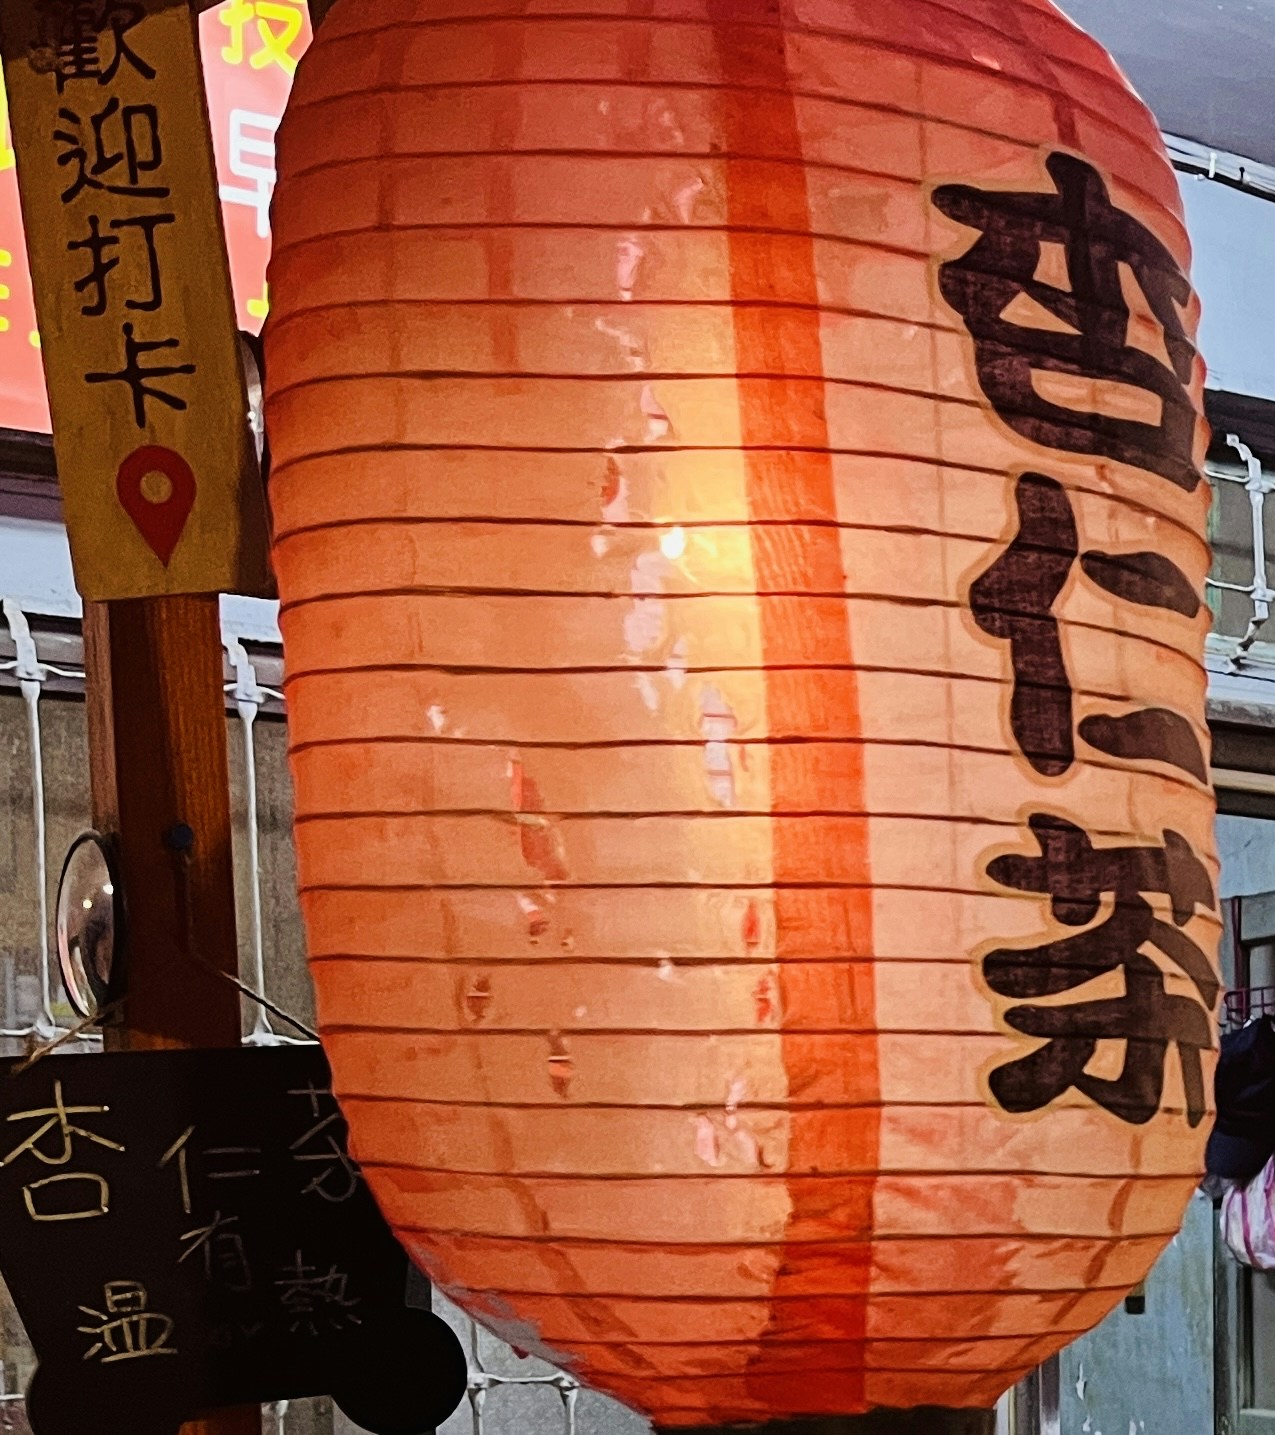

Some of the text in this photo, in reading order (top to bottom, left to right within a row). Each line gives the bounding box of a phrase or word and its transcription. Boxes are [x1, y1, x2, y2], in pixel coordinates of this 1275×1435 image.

[28, 0, 197, 430] 歡迎打卡
[929, 150, 1216, 1127] 杏仁茶
